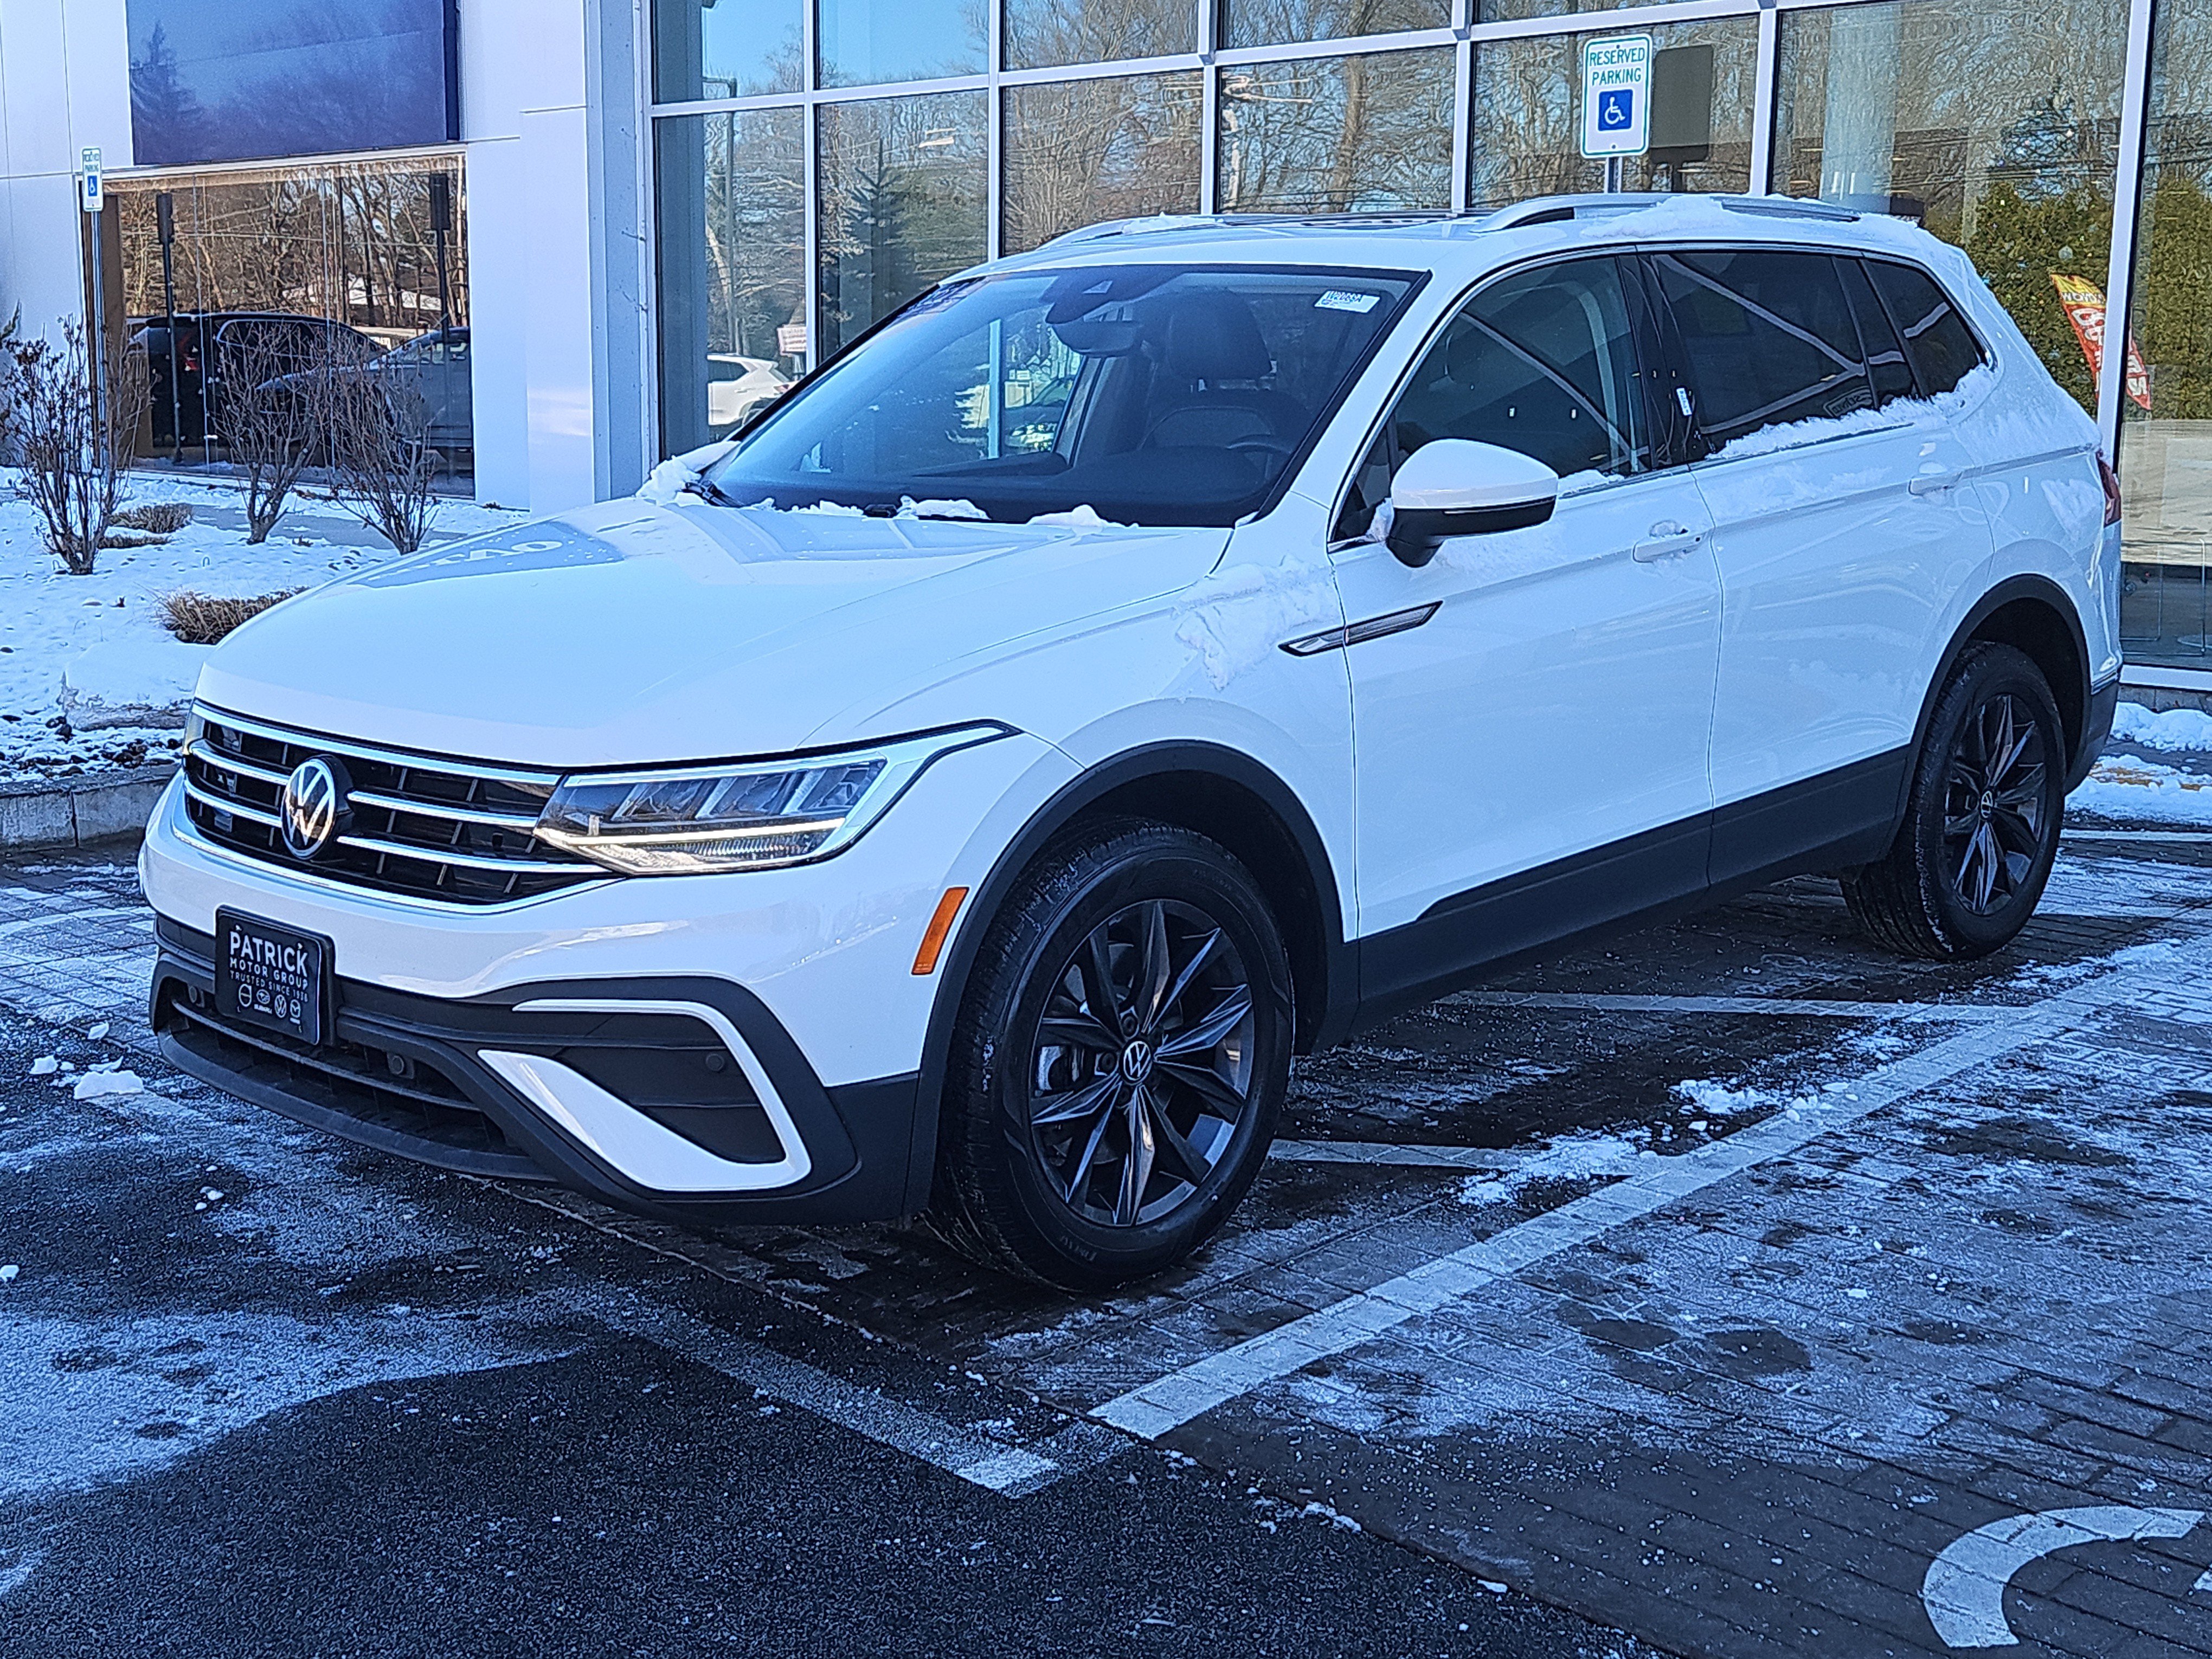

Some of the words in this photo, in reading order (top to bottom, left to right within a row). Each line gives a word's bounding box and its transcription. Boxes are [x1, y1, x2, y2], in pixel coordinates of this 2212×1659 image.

[1590, 47, 1645, 66] RESERVED
[1592, 67, 1641, 86] PARKING
[230, 931, 308, 977] PATRICK
[230, 957, 268, 978] MOTOR
[273, 969, 308, 990] GROUP
[230, 970, 266, 987] TRUSTED
[269, 981, 290, 996] SINCE
